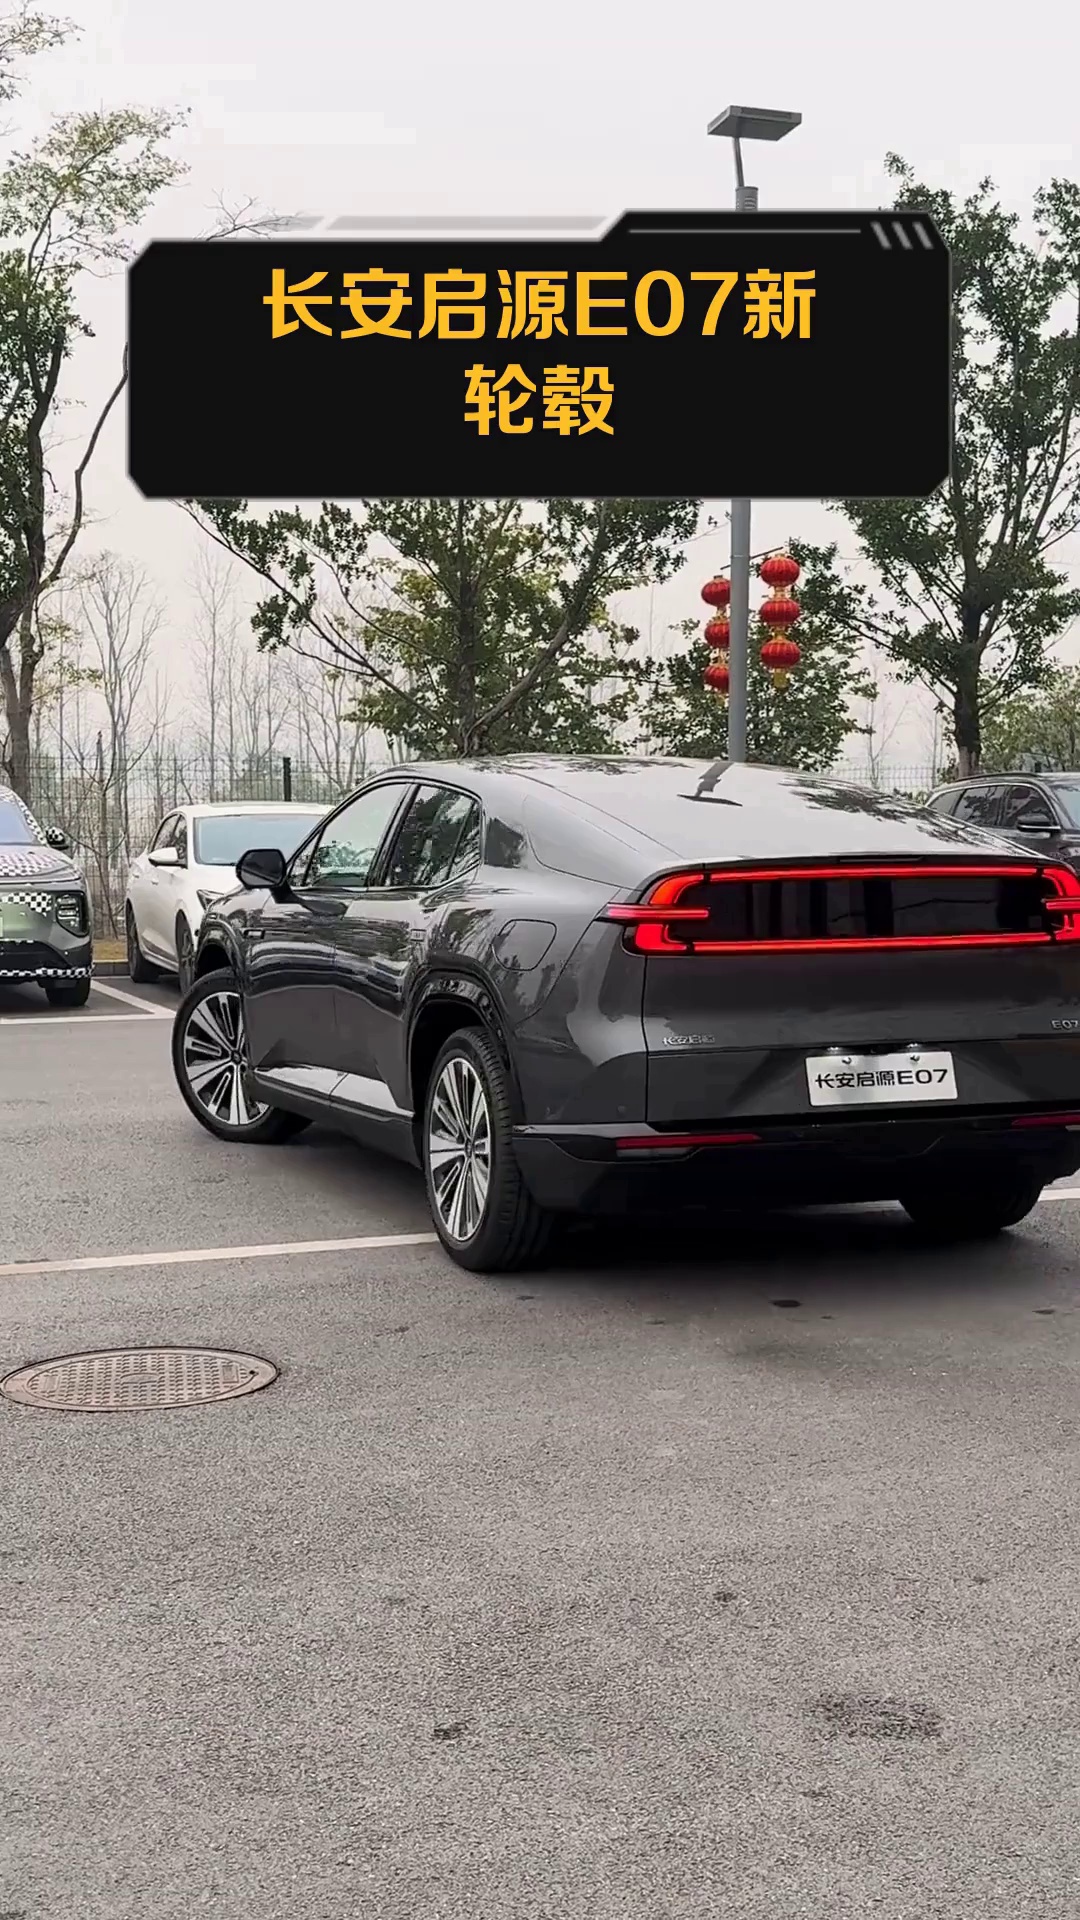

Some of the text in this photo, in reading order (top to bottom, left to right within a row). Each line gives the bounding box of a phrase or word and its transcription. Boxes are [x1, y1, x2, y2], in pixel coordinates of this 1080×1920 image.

[1051, 1020, 1079, 1029] E07
[815, 1068, 949, 1089] 长安启源E07
